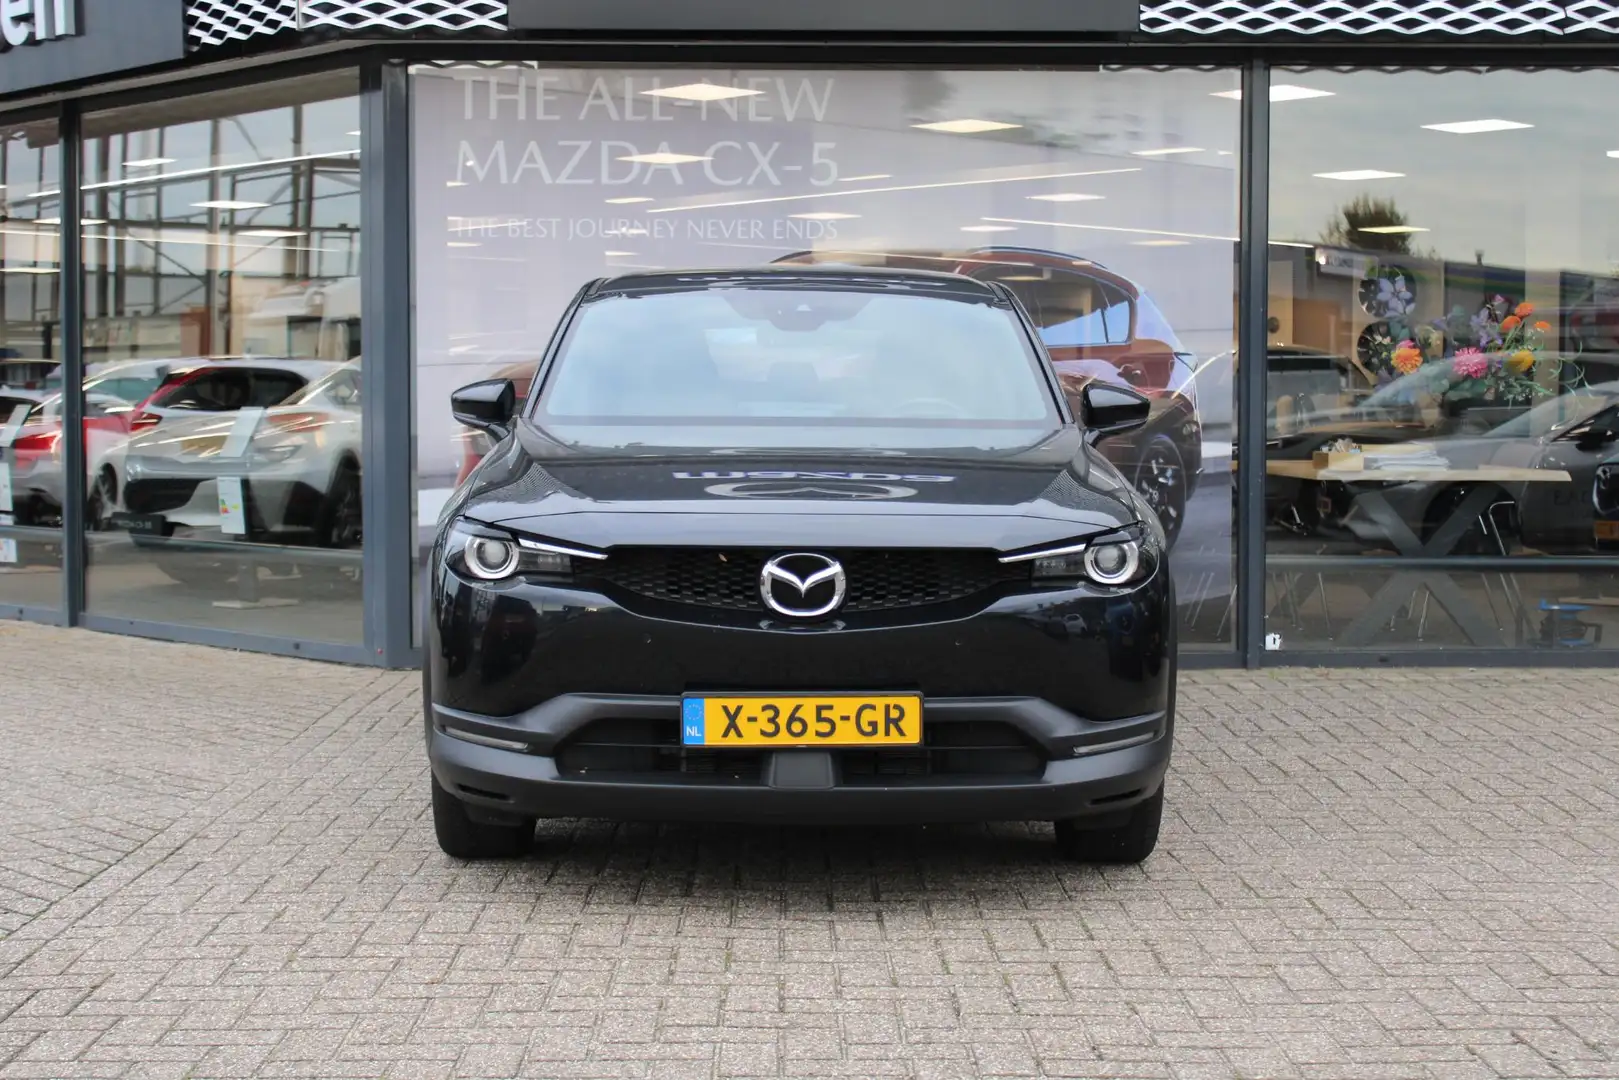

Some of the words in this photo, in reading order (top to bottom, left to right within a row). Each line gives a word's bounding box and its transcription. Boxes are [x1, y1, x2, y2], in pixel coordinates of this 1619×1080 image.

[459, 75, 560, 121] THE
[579, 75, 835, 122] ALL-NEW
[456, 140, 683, 185] MAZDA
[704, 141, 838, 187] CX-5
[456, 219, 502, 238] THE
[508, 219, 561, 238] BEST
[567, 219, 678, 241] JOURNEY
[687, 219, 762, 239] NEVER
[774, 219, 837, 240] ENDS
[686, 727, 701, 737] NL
[721, 703, 907, 739] X-365-GR
